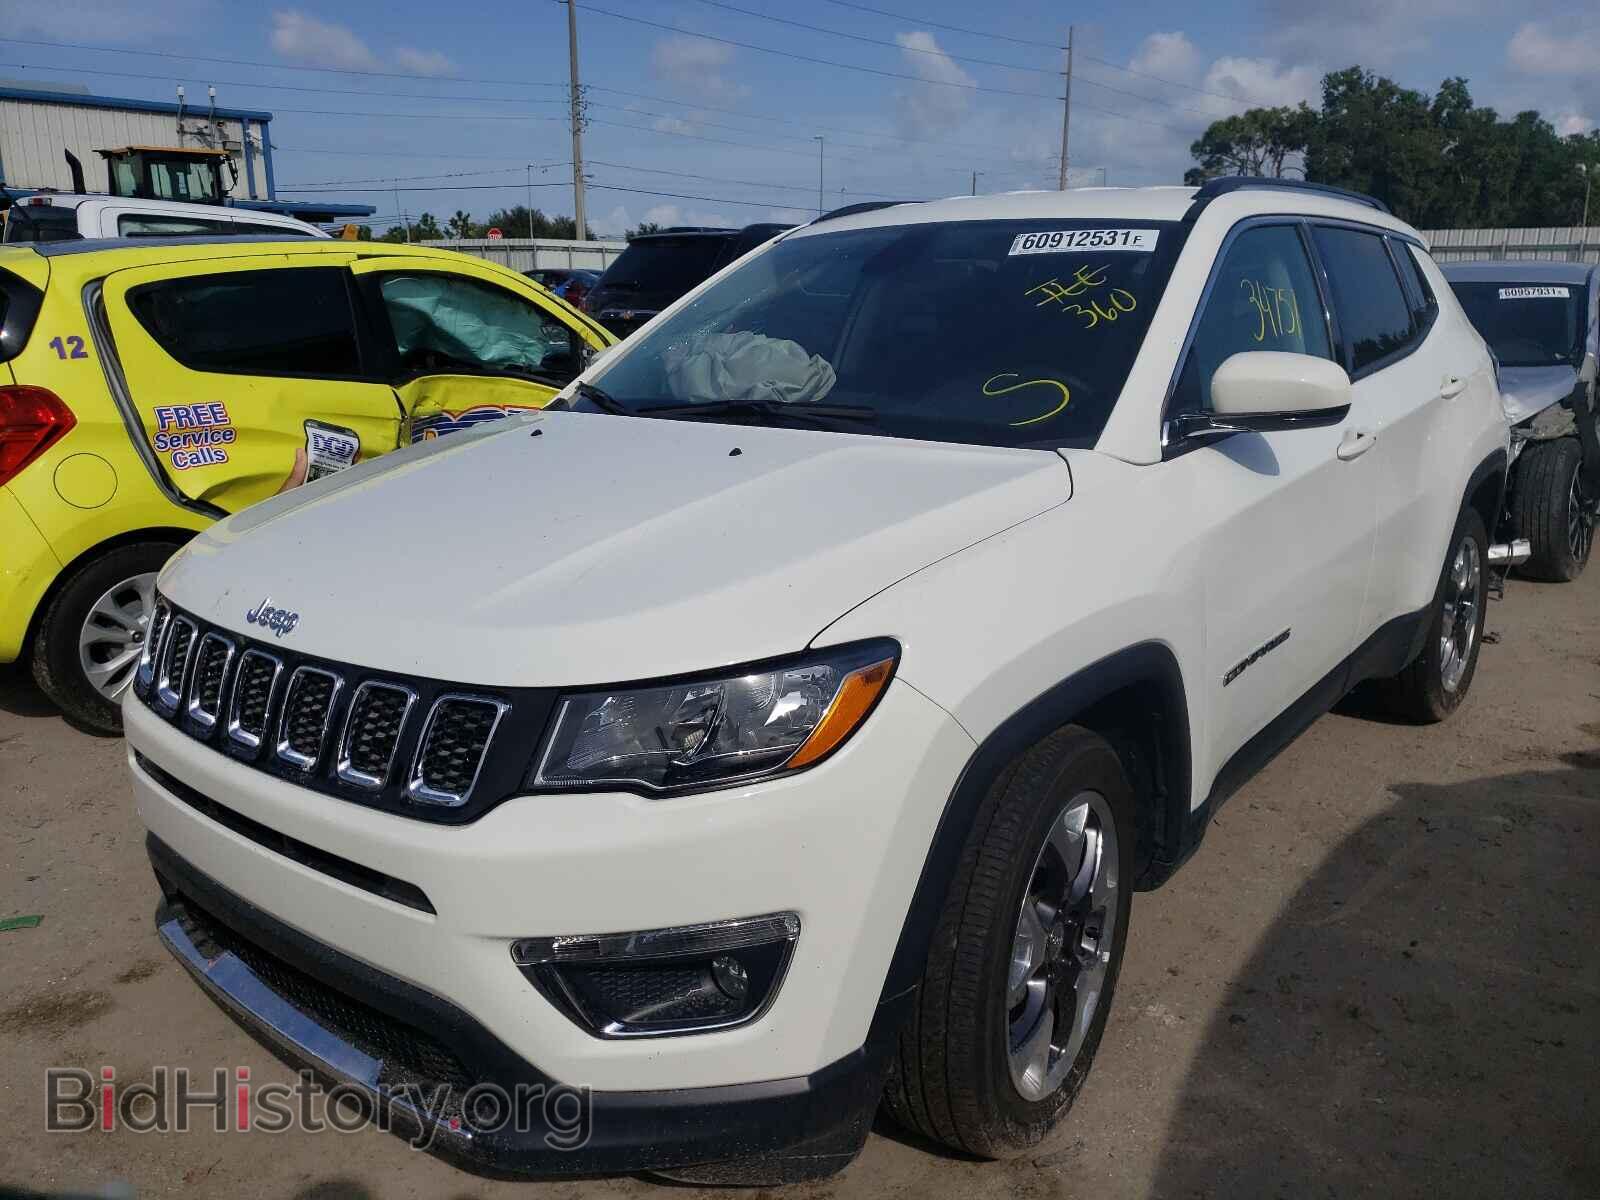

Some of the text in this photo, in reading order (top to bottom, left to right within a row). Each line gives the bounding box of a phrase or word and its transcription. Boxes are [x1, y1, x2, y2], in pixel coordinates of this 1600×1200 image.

[1022, 230, 1131, 250] 60912531
[1062, 289, 1137, 328] 360
[49, 336, 89, 360] 12
[155, 403, 230, 430] FREE
[154, 429, 235, 450] Service
[172, 447, 227, 469] Calls
[246, 598, 298, 638] Jeep
